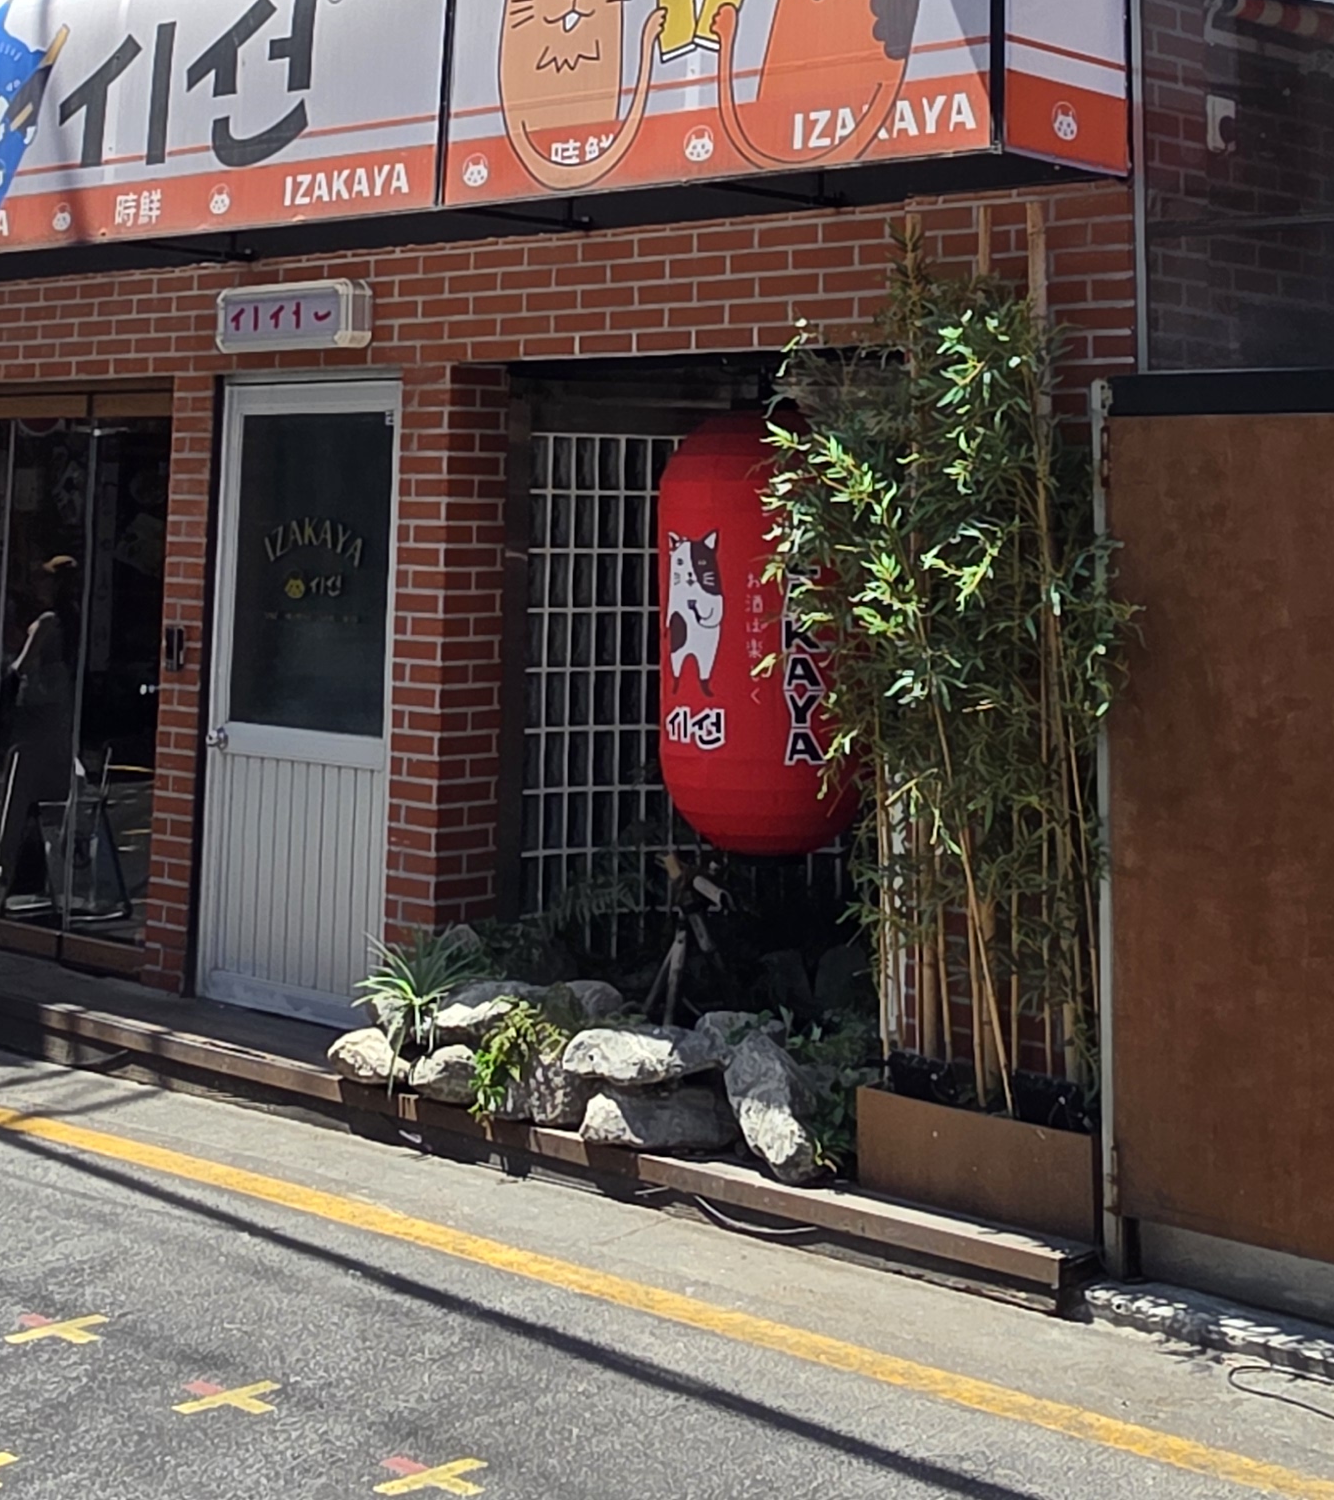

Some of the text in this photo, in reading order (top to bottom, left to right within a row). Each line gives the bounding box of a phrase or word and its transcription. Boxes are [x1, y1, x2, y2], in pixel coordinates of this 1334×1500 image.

[283, 161, 409, 206] IZAKAYA
[115, 189, 162, 227] 時鮮
[264, 517, 363, 568] IZAKAYA
